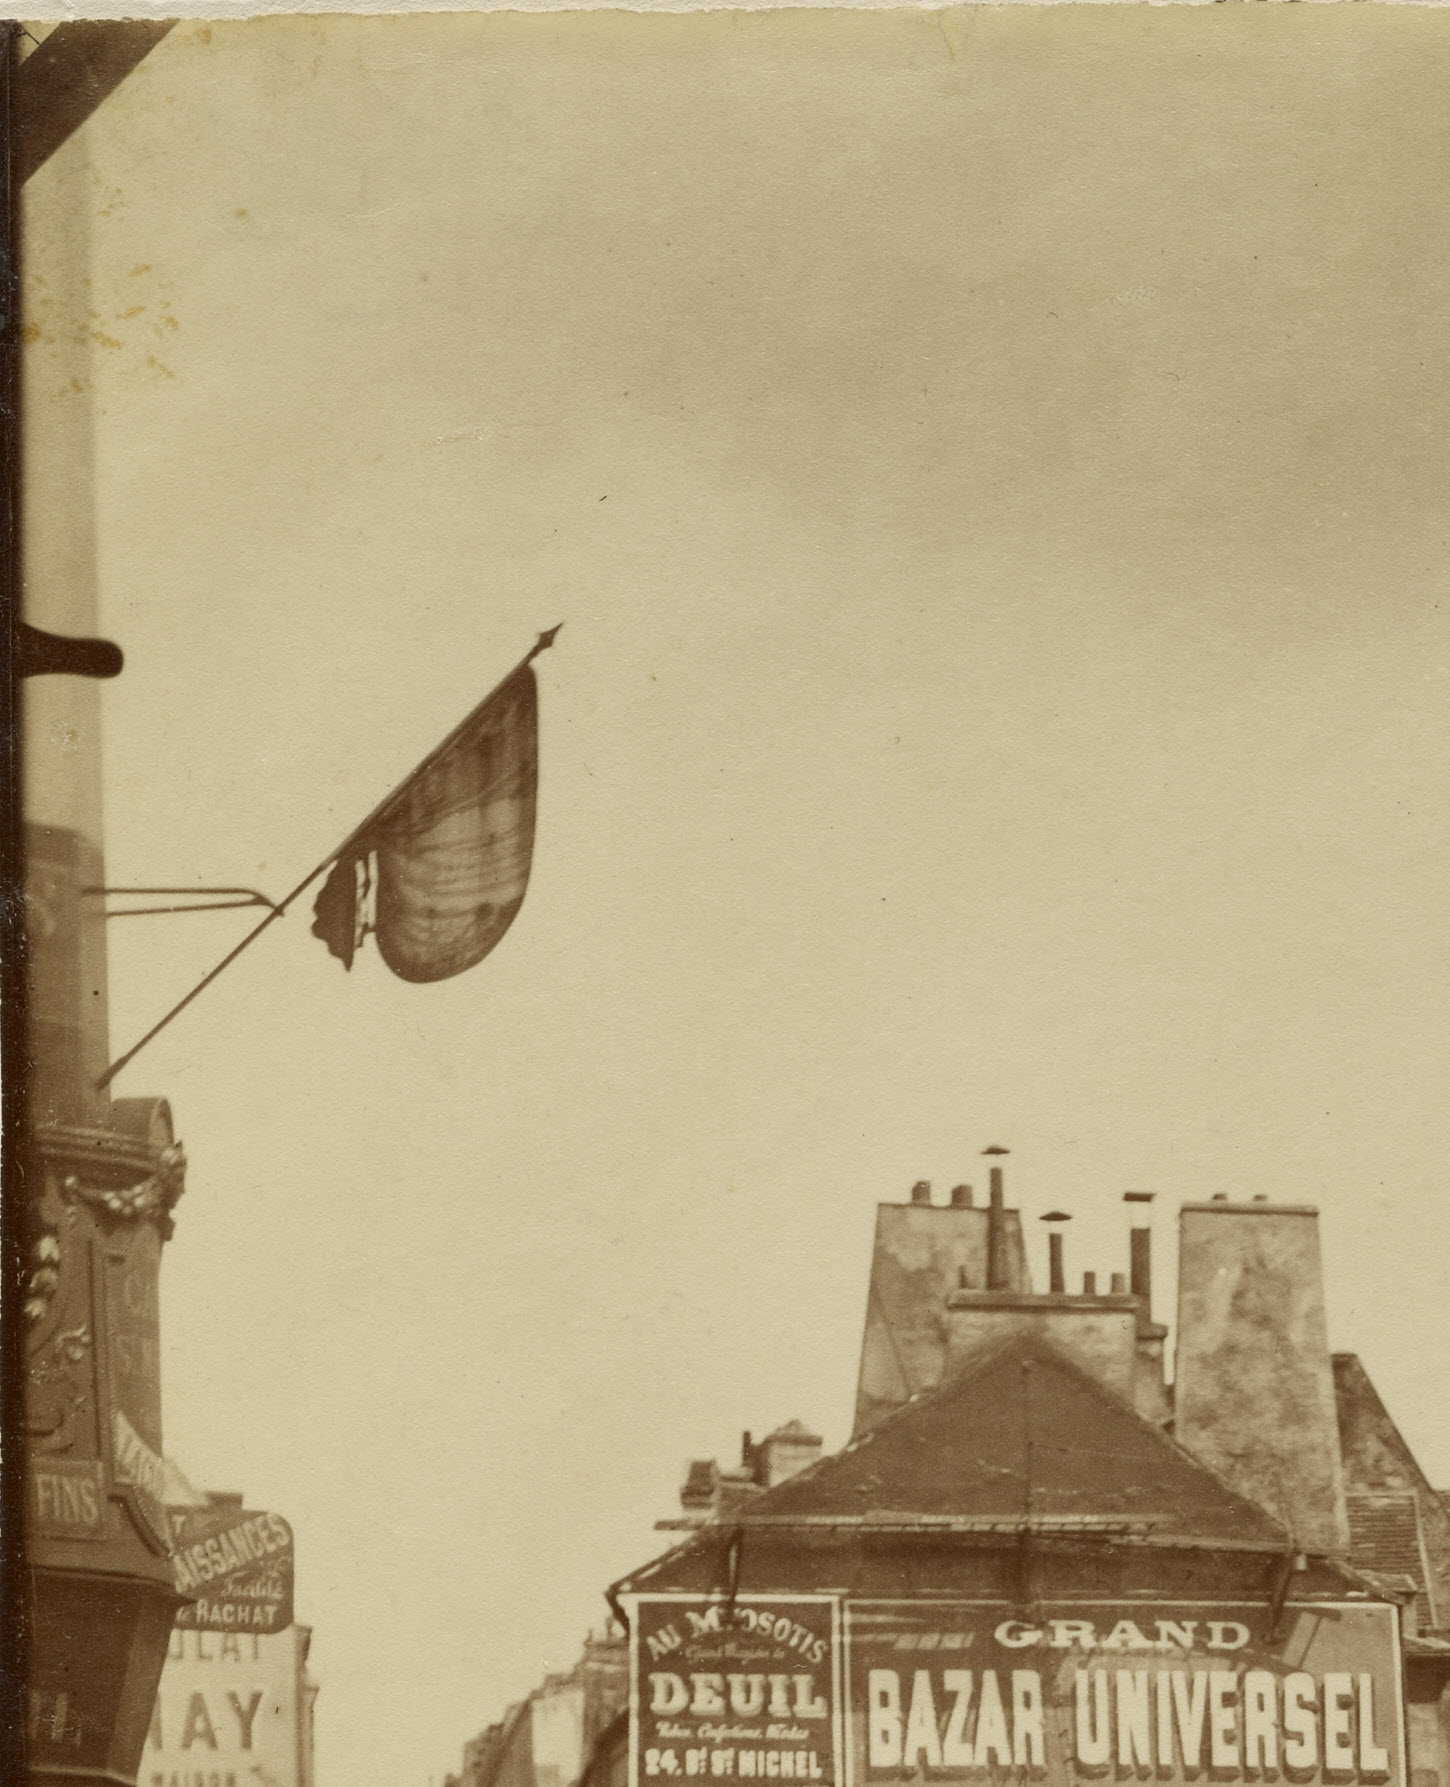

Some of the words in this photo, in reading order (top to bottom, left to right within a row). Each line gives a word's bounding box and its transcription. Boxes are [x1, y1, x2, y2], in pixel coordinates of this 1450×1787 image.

[36, 1473, 98, 1525] FINS
[195, 1599, 278, 1626] RACHAT
[645, 1623, 682, 1661] AU
[993, 1619, 1251, 1649] GRAND
[648, 1671, 828, 1719] DEUIL
[867, 1668, 1048, 1776] BAZAR
[1074, 1669, 1391, 1780] UNIVERSEL
[739, 1750, 824, 1779] MICHEL
